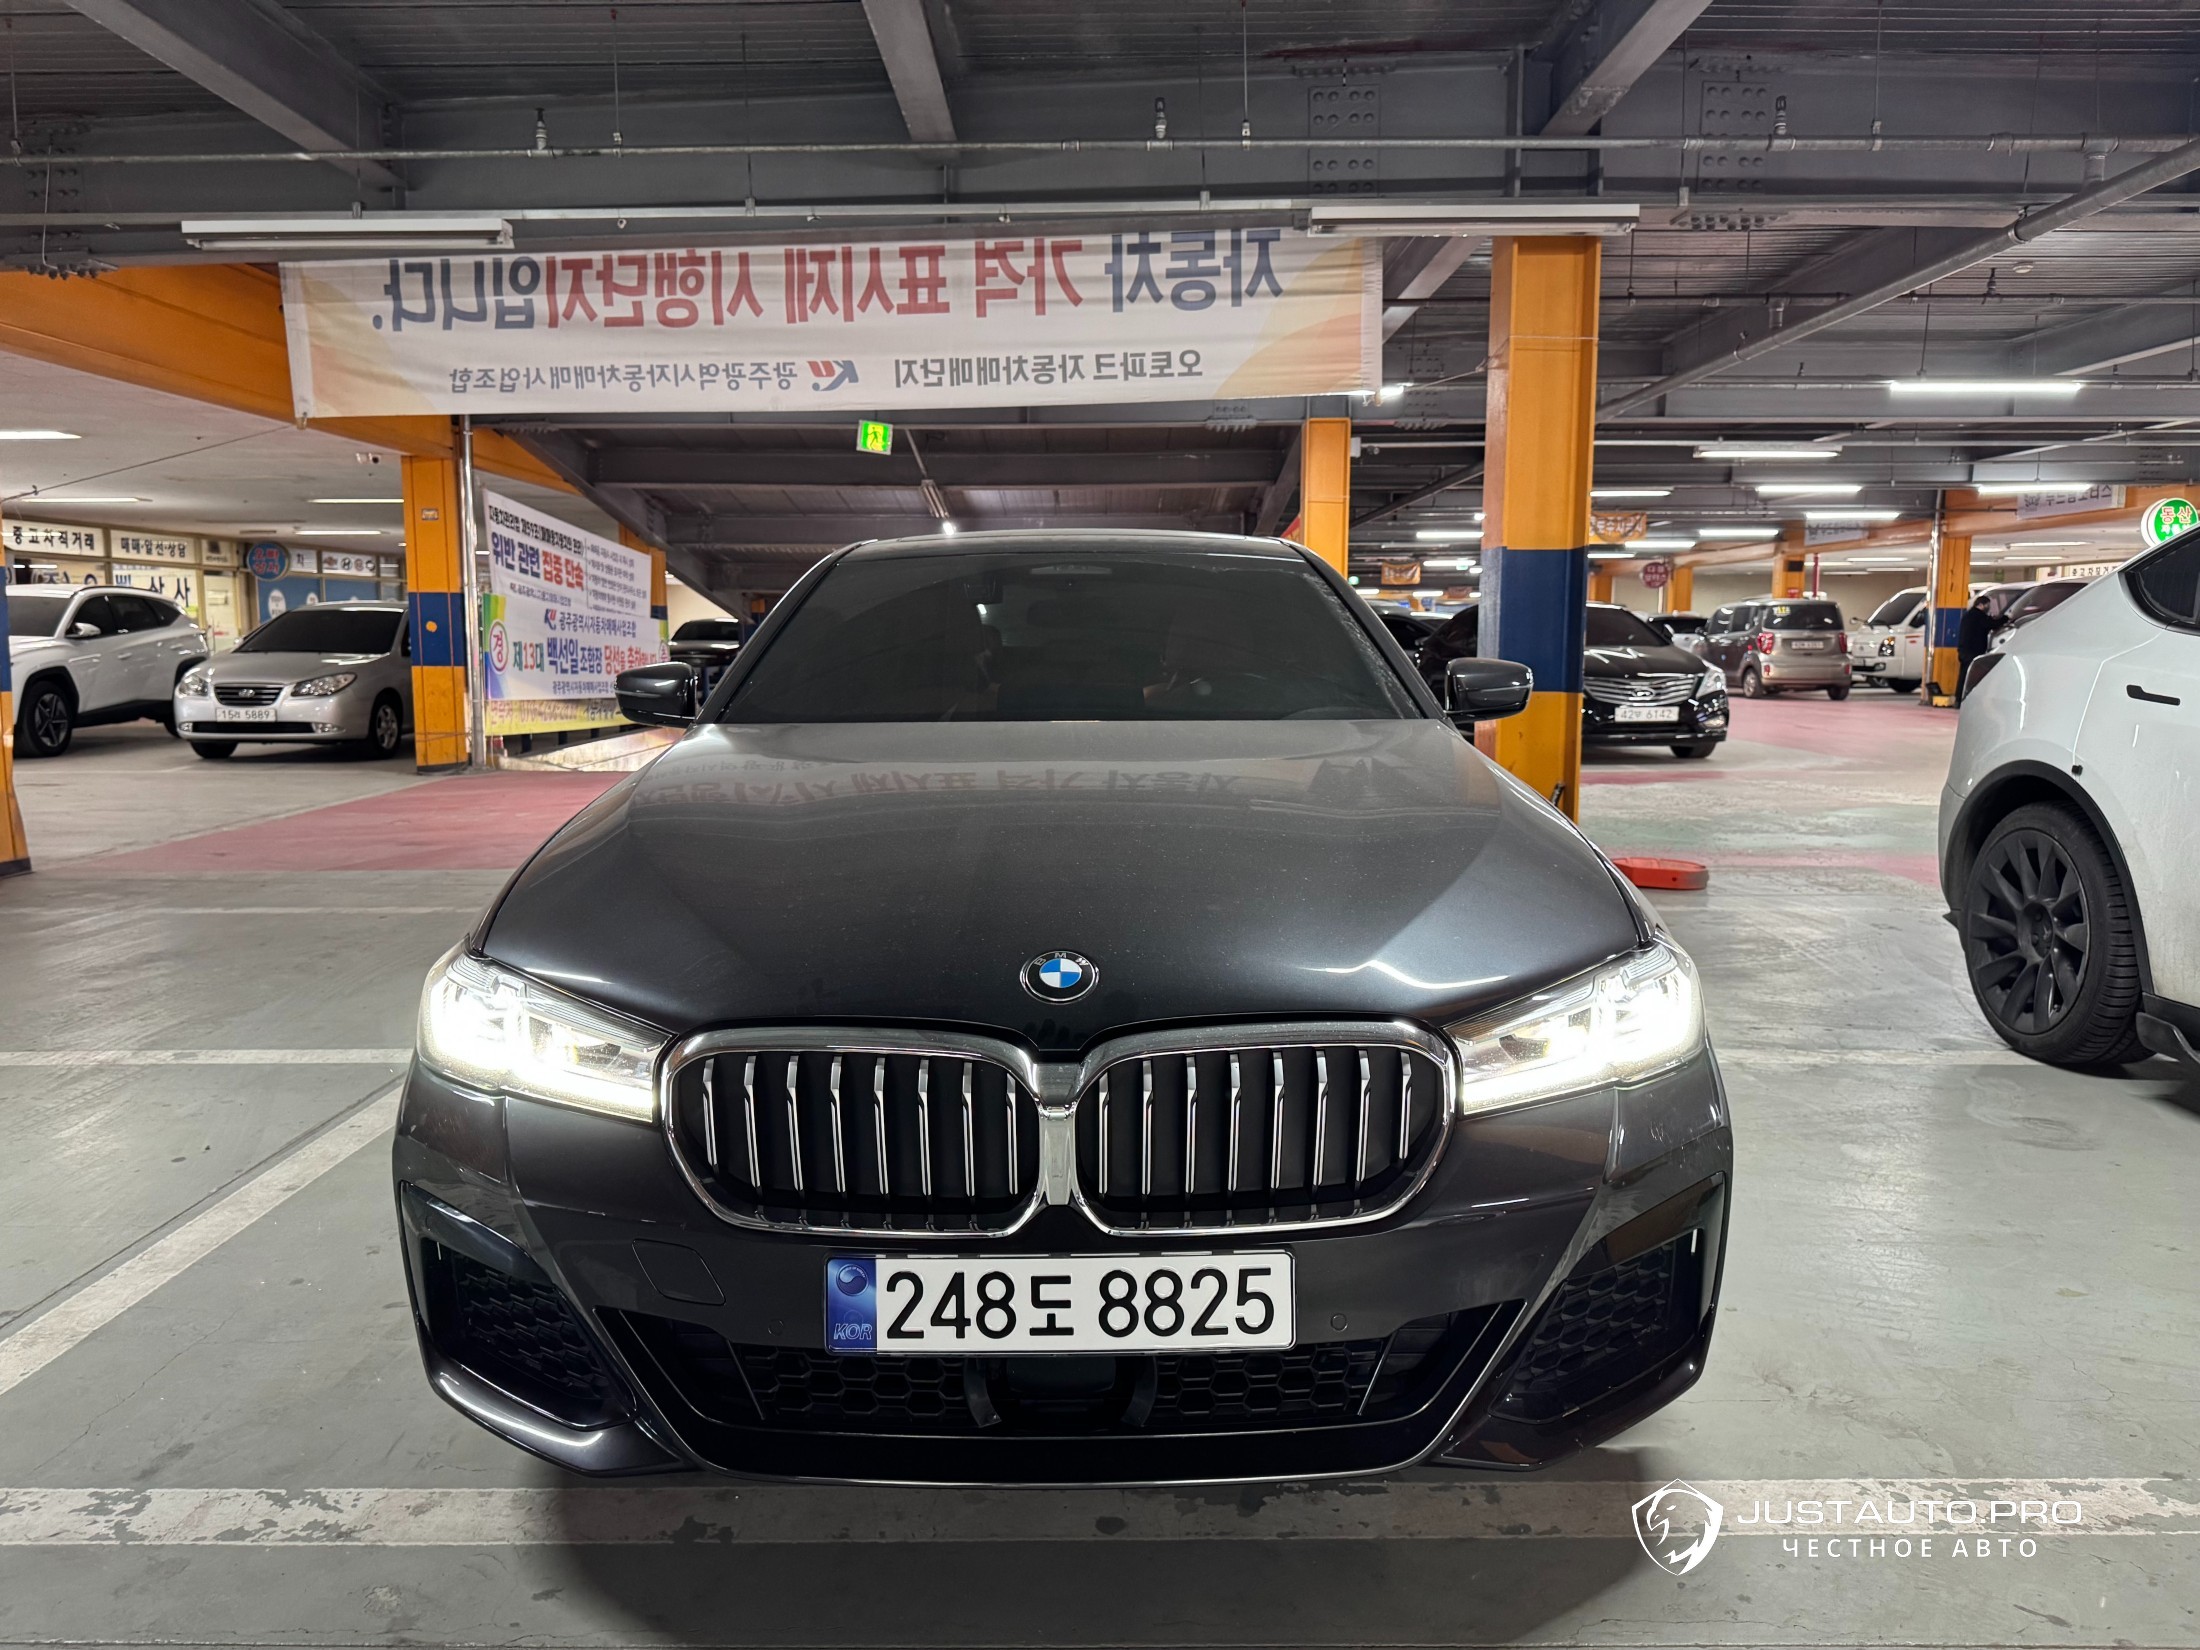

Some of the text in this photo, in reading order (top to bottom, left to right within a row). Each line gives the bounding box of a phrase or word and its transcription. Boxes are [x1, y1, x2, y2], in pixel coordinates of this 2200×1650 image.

[2161, 506, 2193, 524] 동산
[13, 526, 95, 551] 중고차직거래
[491, 531, 516, 571] 위반
[517, 541, 541, 579] 관련
[542, 550, 564, 586] 집중
[564, 557, 585, 592] 단속
[493, 630, 504, 663] 경
[512, 641, 545, 672] 제13대
[546, 637, 579, 675] 백선일
[580, 645, 603, 674] 조합장
[1034, 952, 1089, 966] BMW
[886, 1266, 1275, 1340] 248도 8825
[833, 1323, 873, 1341] KOR
